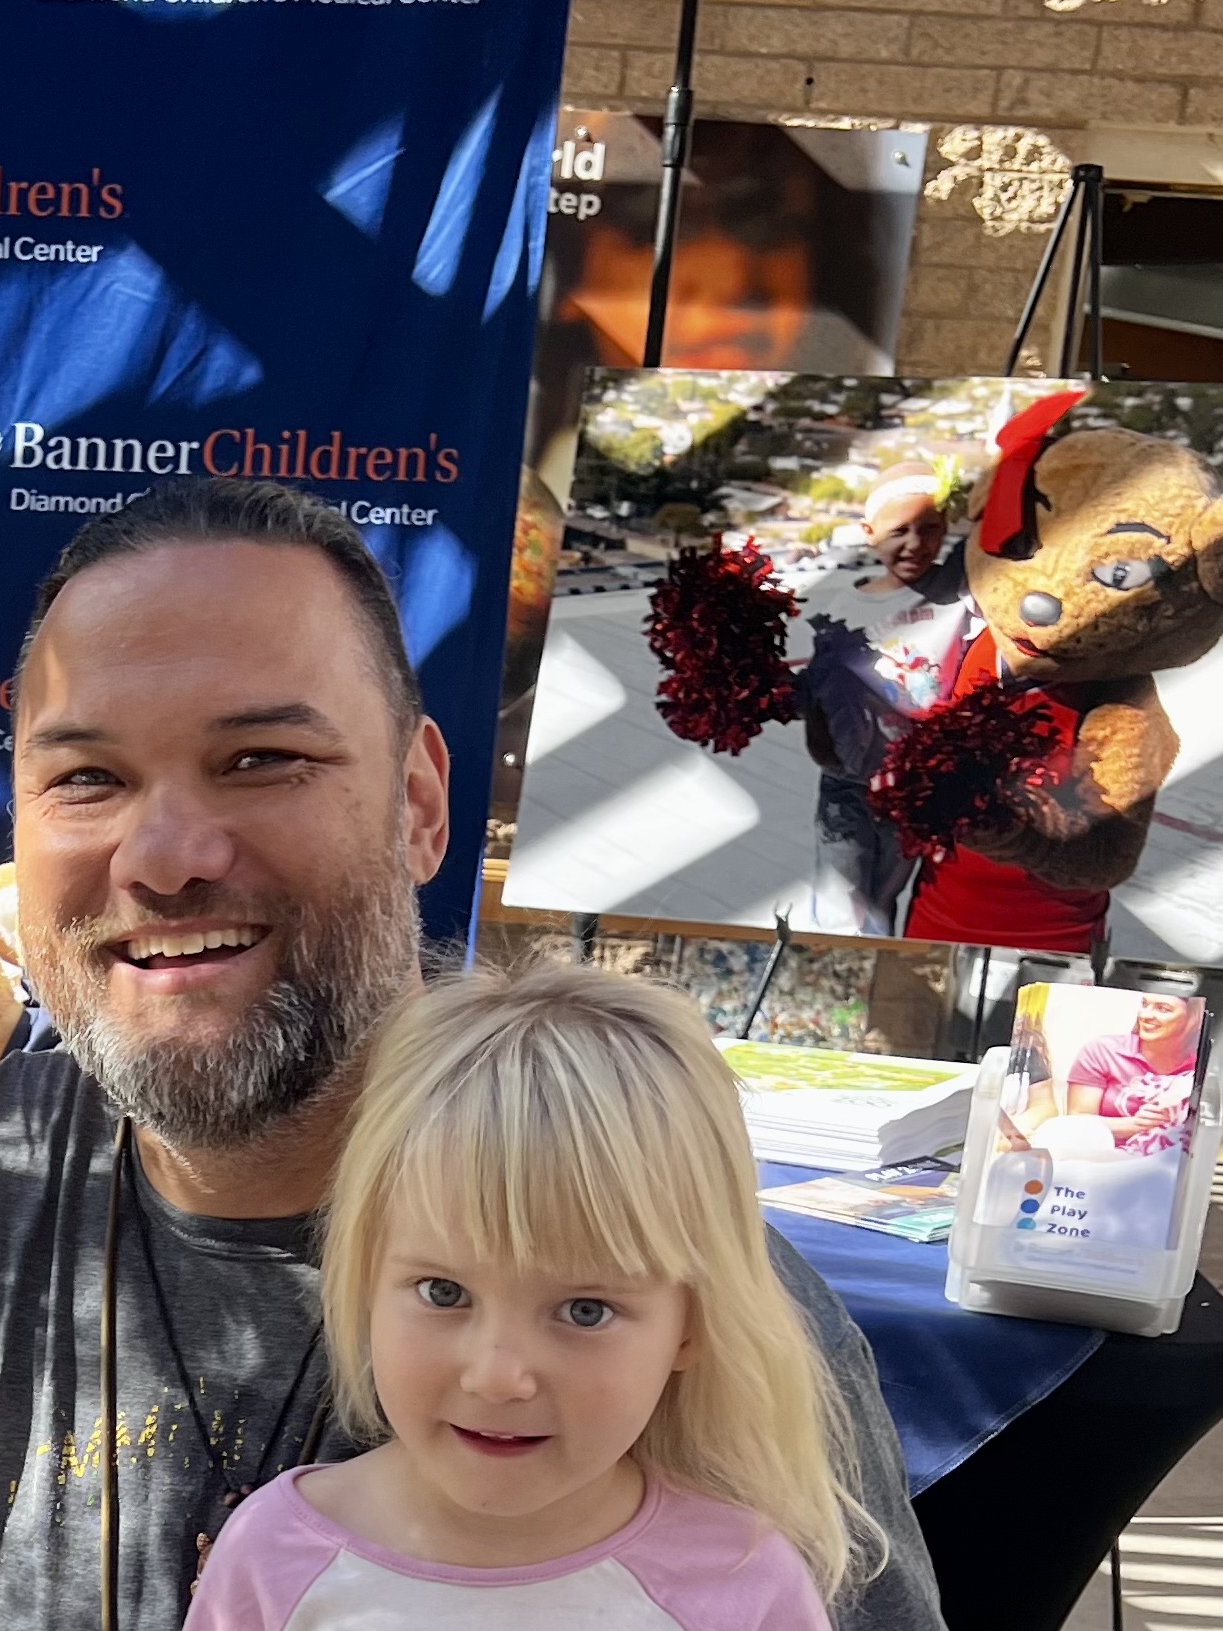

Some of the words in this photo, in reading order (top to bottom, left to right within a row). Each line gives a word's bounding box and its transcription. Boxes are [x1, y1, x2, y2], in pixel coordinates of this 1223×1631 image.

[547, 187, 602, 221] tep
[14, 236, 104, 263] Center
[10, 488, 124, 514] Diamond
[350, 500, 440, 526] Center
[1053, 1186, 1086, 1200] The
[1050, 1203, 1088, 1220] Play
[1046, 1222, 1092, 1238] Zone
